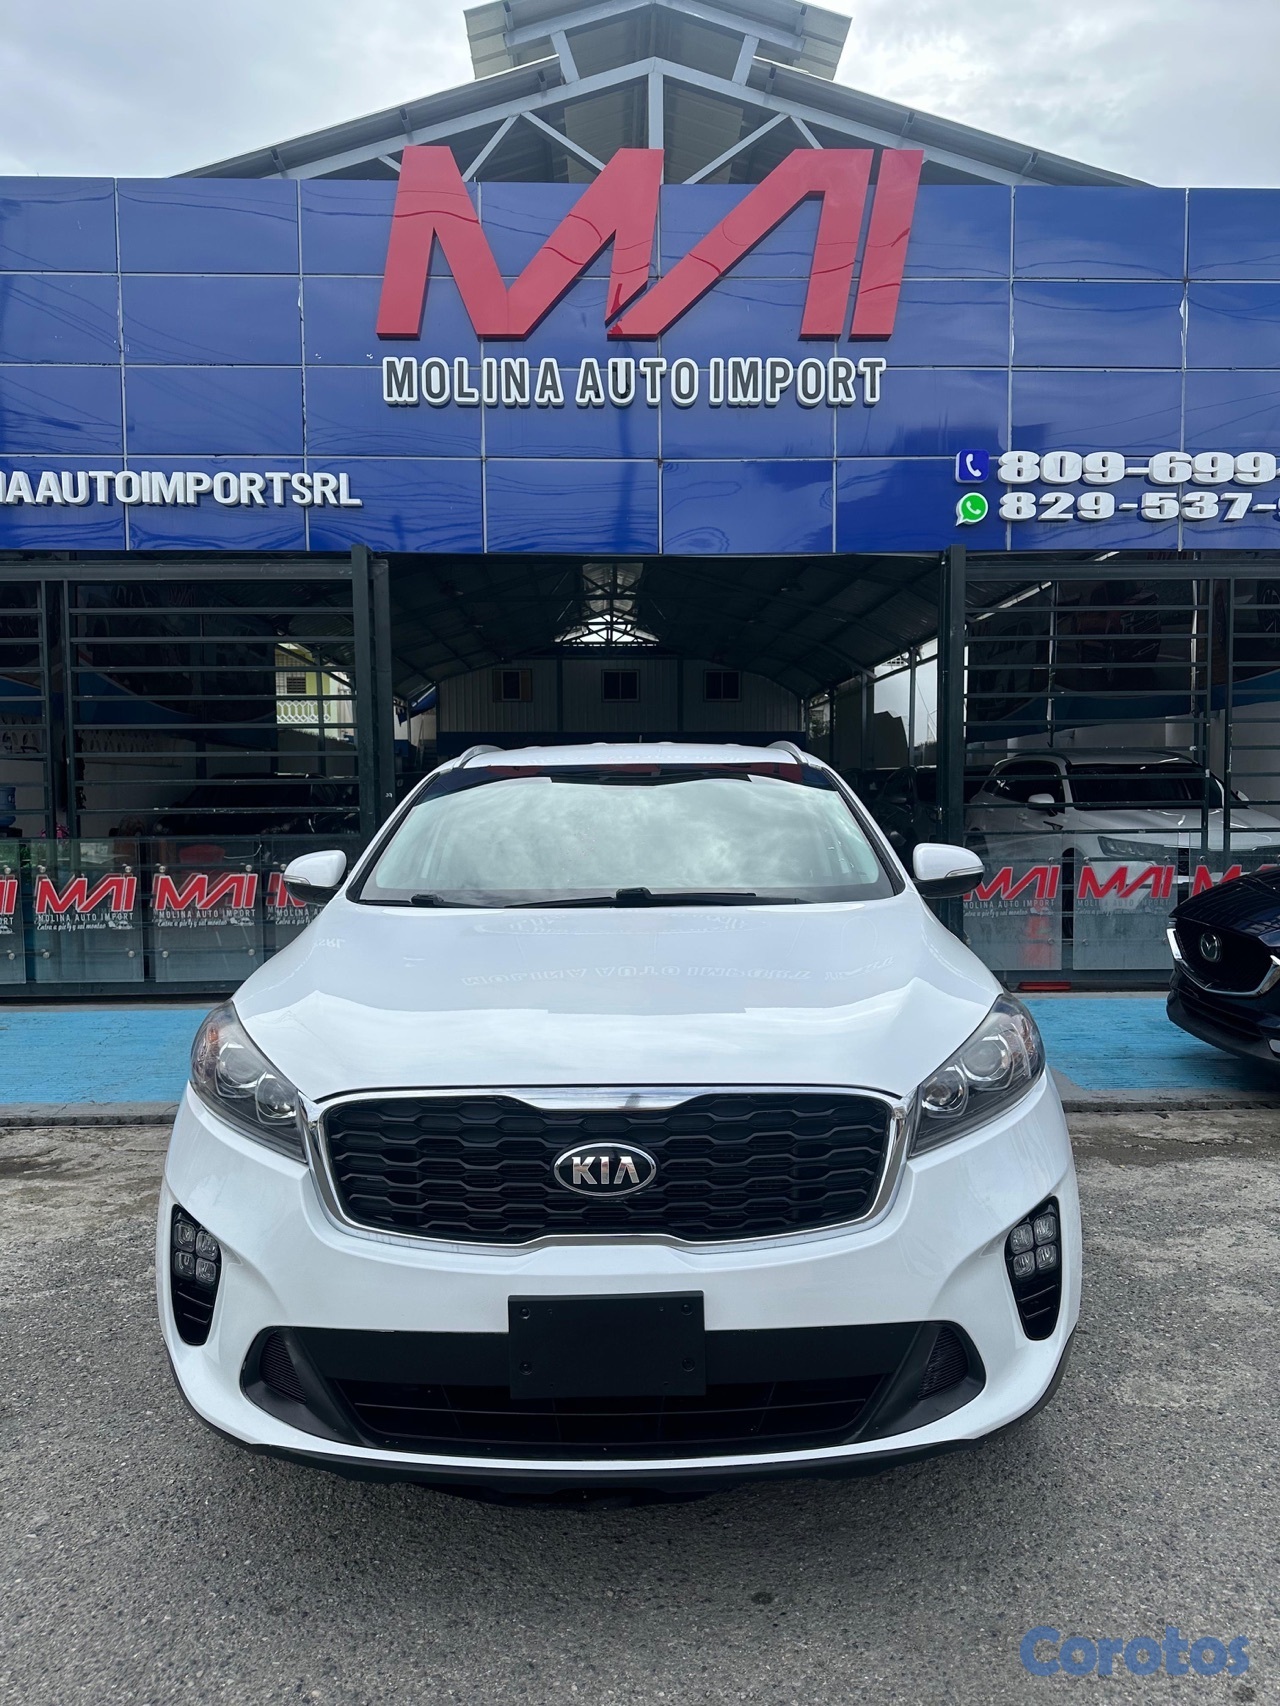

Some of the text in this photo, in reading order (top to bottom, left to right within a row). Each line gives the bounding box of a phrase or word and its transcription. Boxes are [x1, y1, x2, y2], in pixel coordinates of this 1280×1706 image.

[376, 145, 925, 341] MAI
[381, 356, 887, 407] MOLINA AUTO IMPORT
[998, 450, 1280, 485] 809-699
[0, 470, 363, 506] AAUTOIMPORTSRL
[999, 491, 1280, 522] 829-537-
[38, 912, 134, 923] MOLINA AUTO IMPORT
[158, 909, 256, 919] MOLINA AUTO IMPORT
[277, 908, 310, 917] MOLINA
[963, 899, 1055, 909] MOLINA AUTO IMPORT
[571, 1155, 640, 1185] KIA
